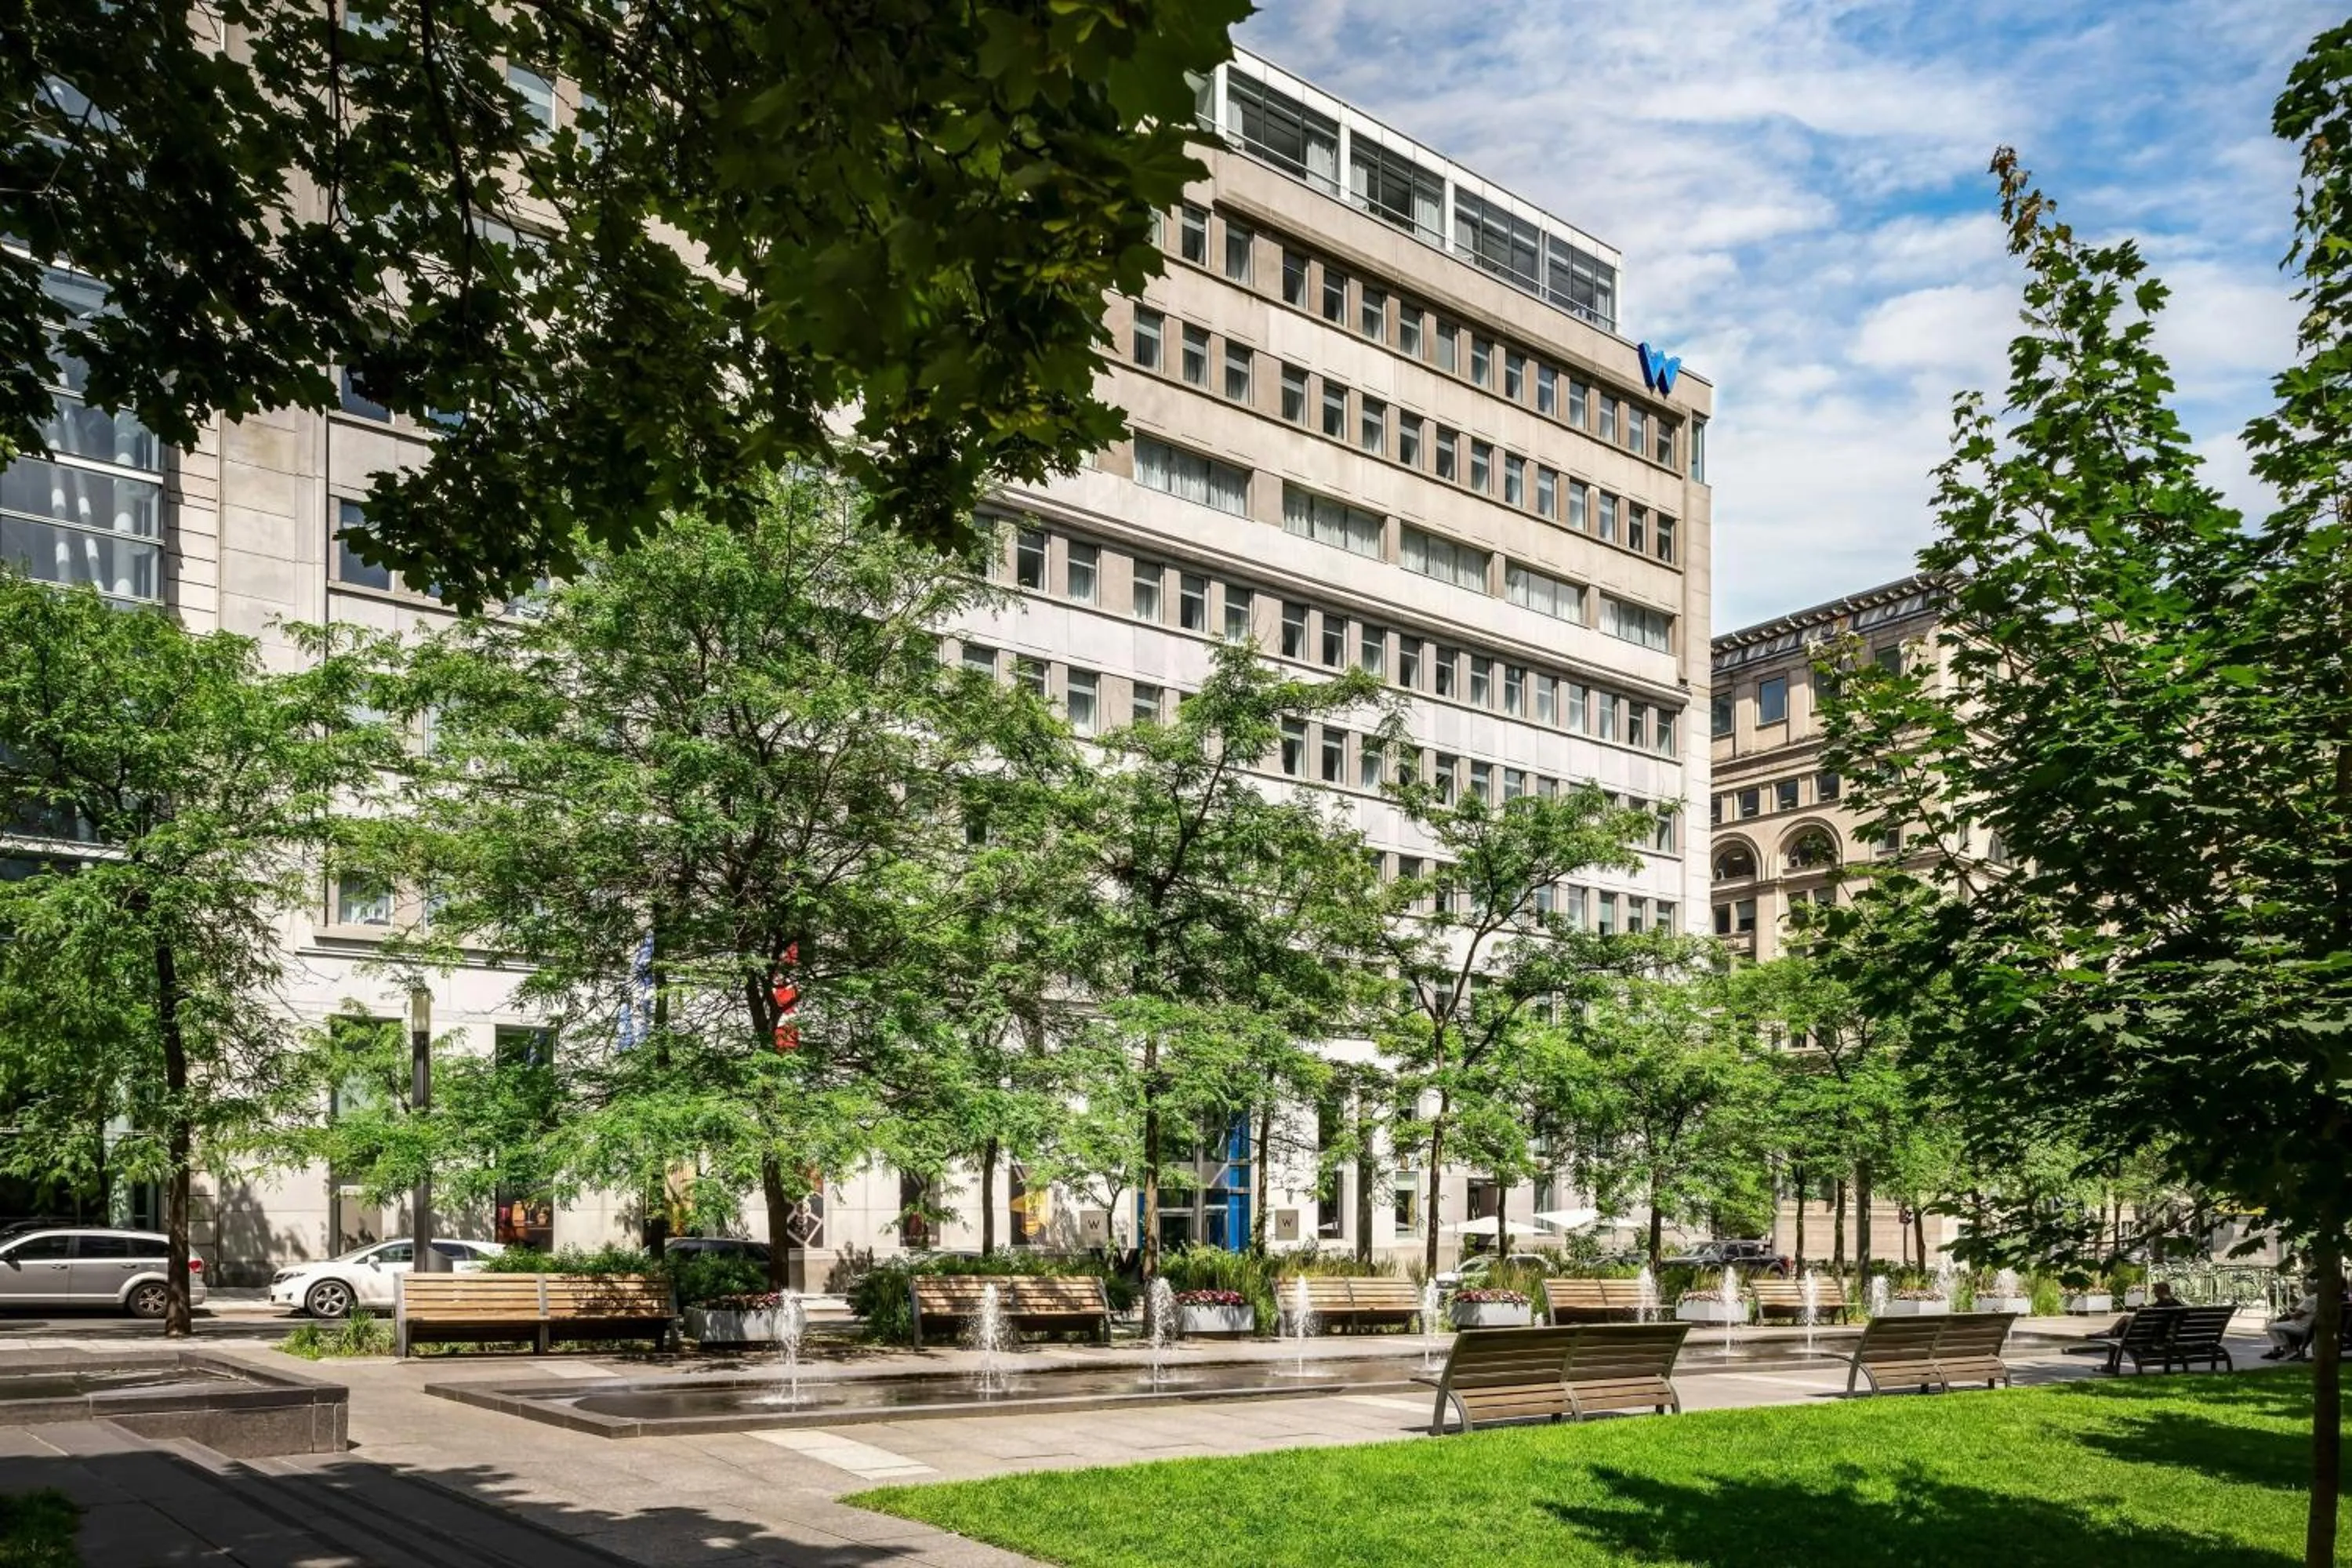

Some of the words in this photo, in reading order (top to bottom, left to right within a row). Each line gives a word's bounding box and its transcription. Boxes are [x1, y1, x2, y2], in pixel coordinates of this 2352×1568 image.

[1638, 340, 1682, 399] W
[1087, 1219, 1100, 1230] W
[1282, 1218, 1293, 1227] W
